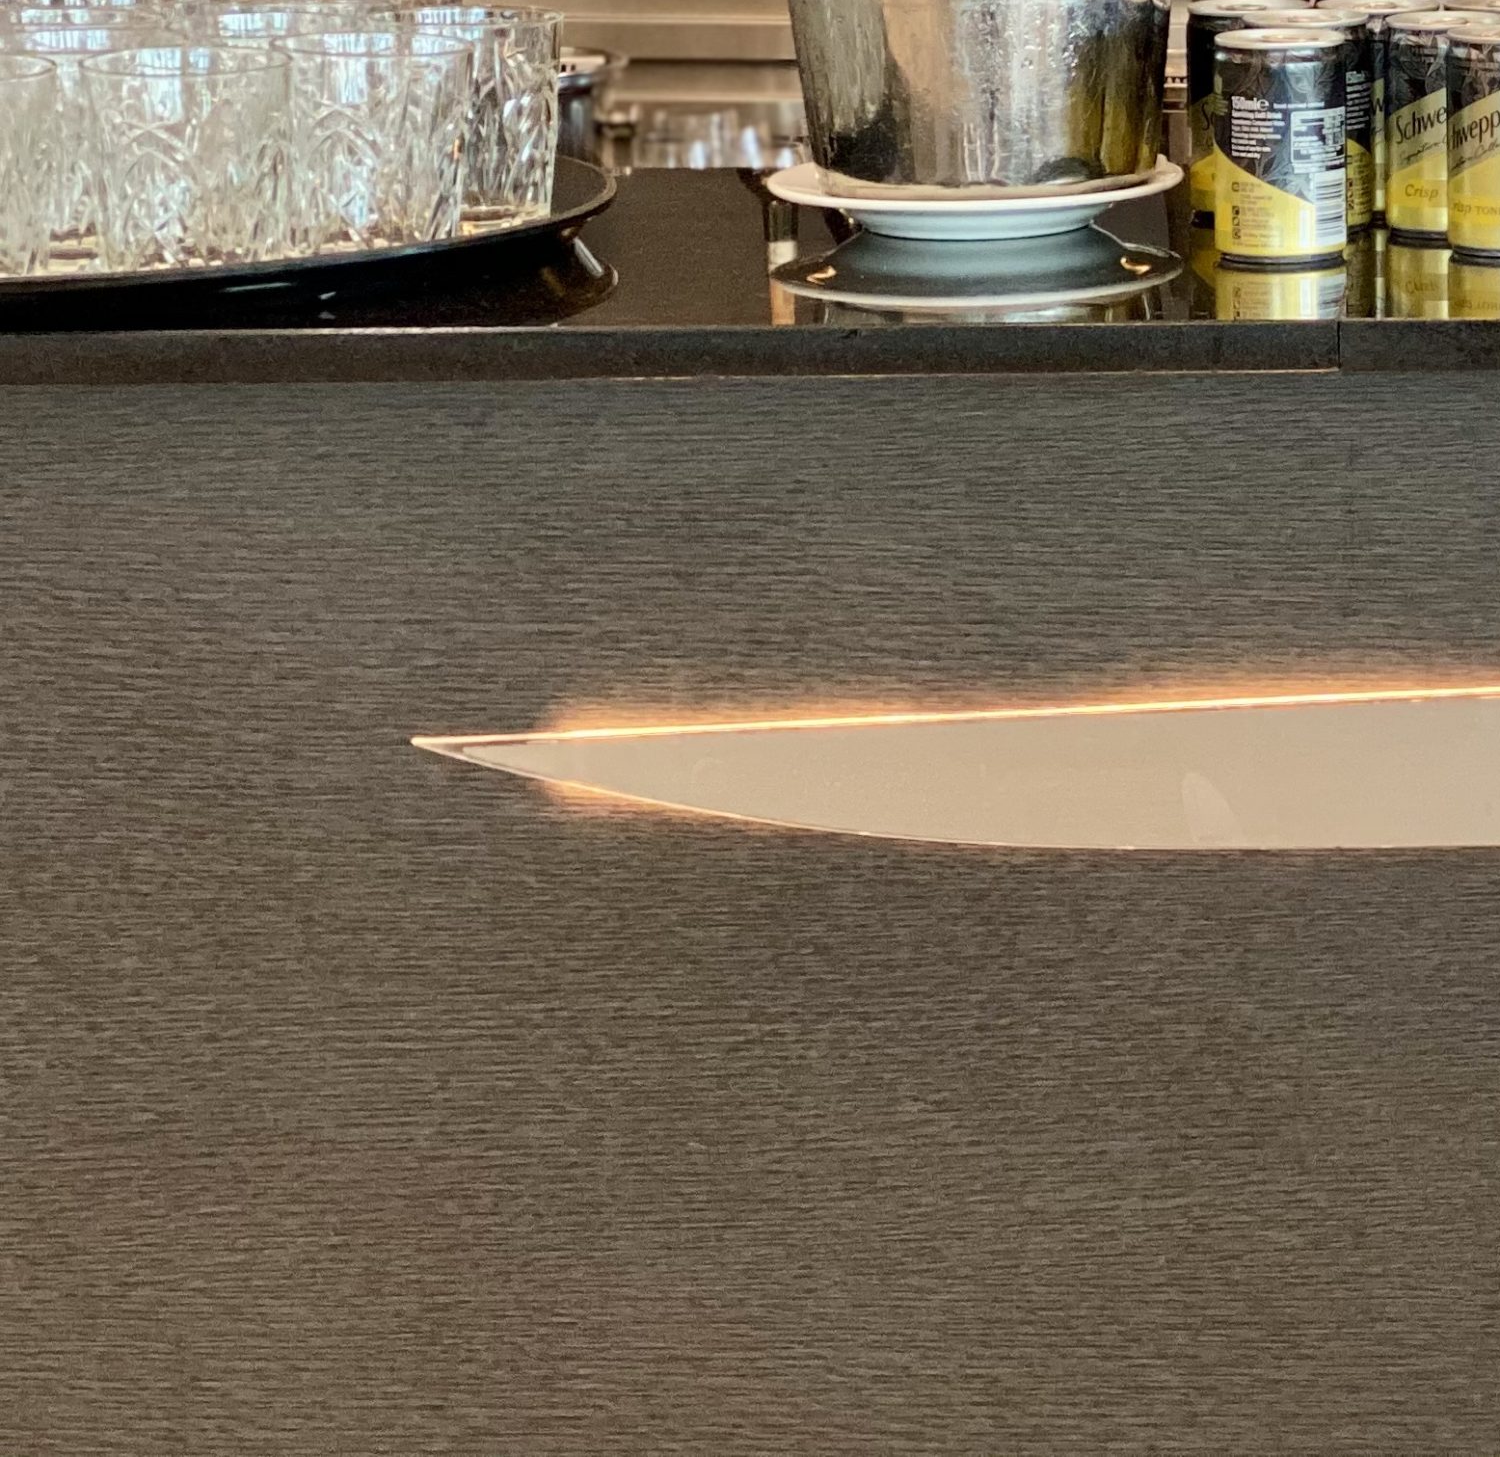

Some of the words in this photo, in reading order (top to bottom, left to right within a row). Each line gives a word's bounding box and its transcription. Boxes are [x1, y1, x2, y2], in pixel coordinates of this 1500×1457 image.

[1396, 105, 1447, 144] Schwe
[1405, 183, 1438, 201] Crisp
[1452, 201, 1471, 215] risp
